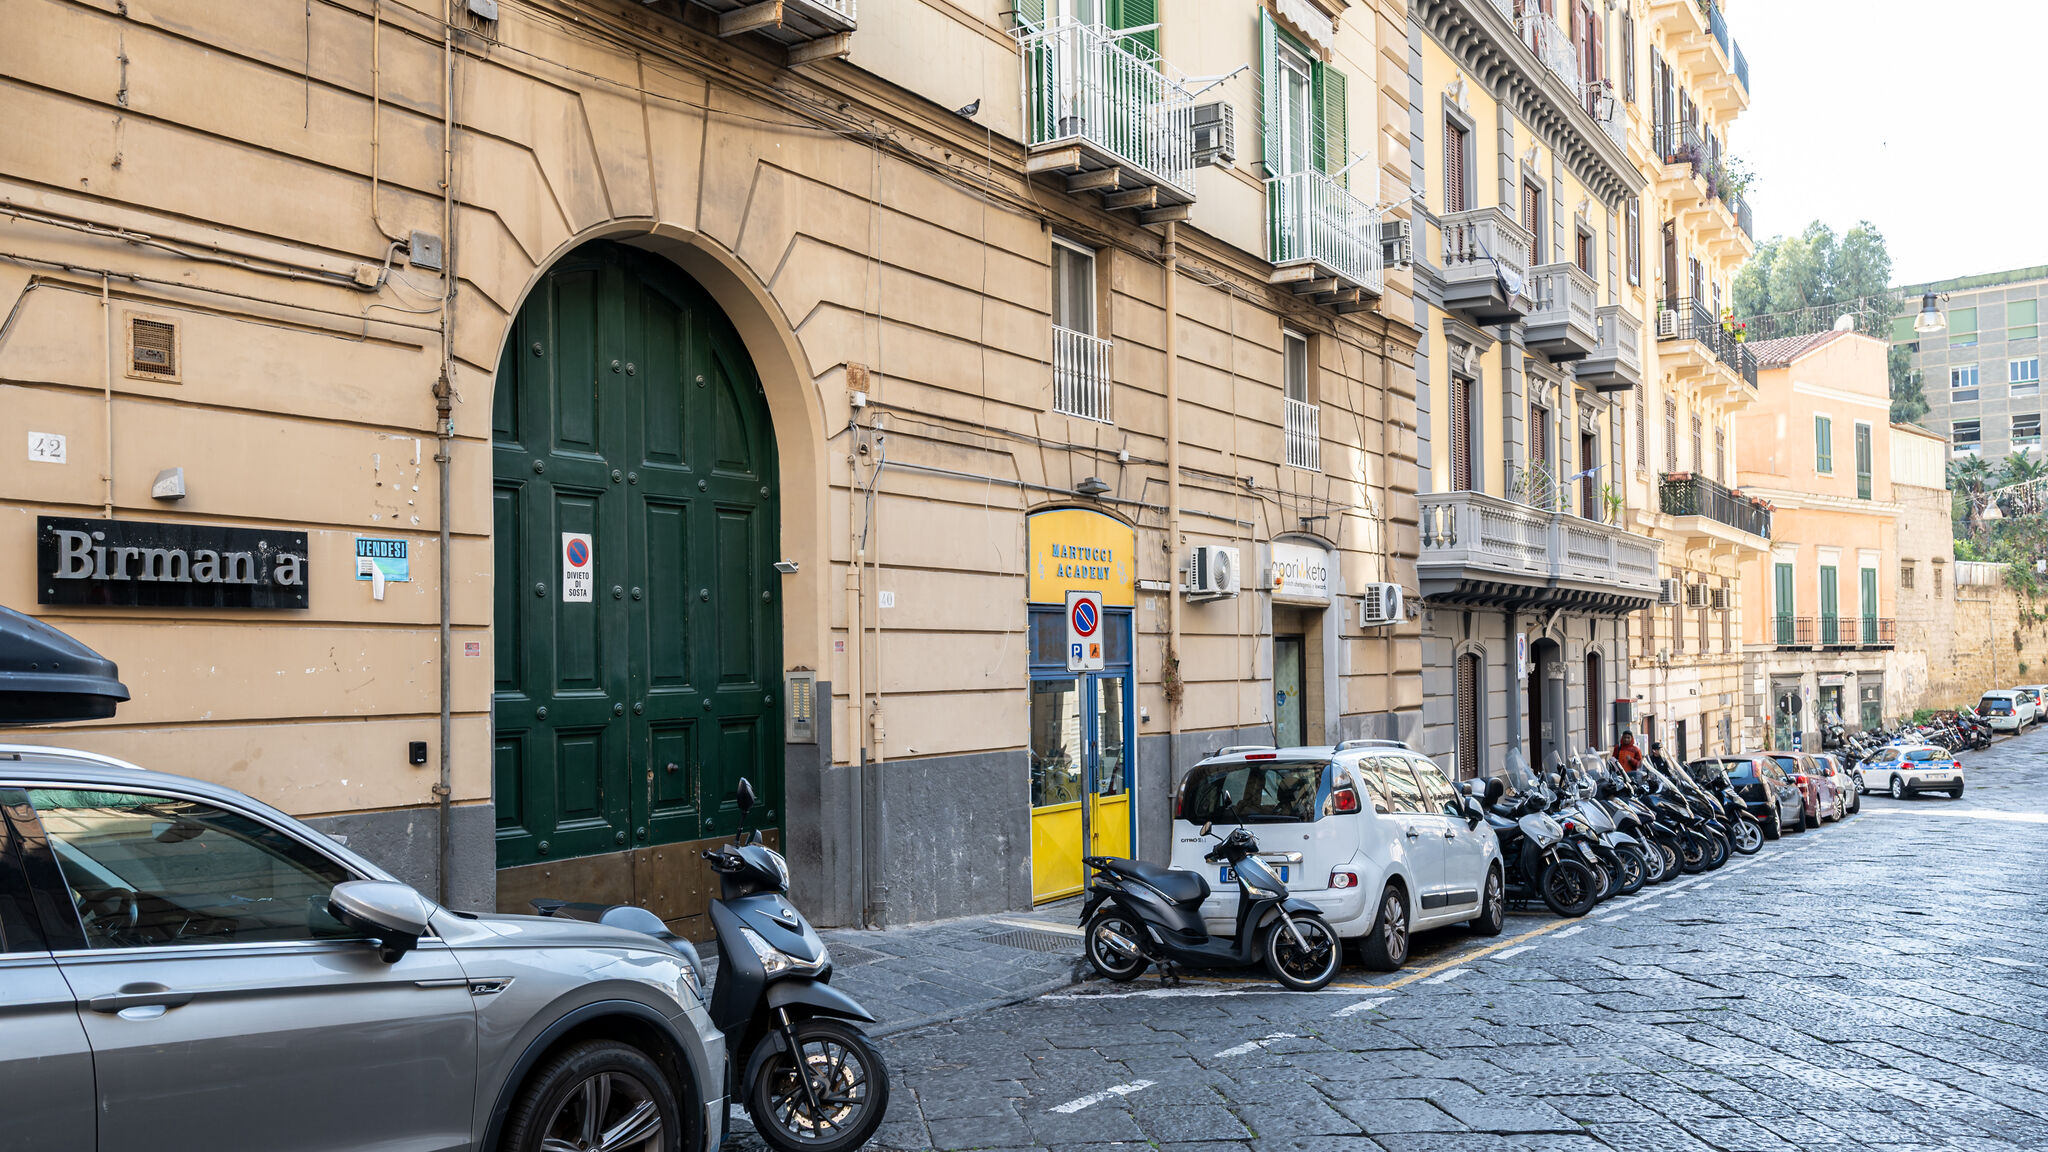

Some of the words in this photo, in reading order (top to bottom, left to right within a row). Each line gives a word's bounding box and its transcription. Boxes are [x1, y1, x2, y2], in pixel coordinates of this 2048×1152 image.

[33, 438, 61, 458] 42
[52, 529, 304, 586] Birmana
[358, 540, 405, 558] VENDESI
[1052, 543, 1113, 562] MARTUCCI
[566, 571, 590, 580] DIVIETO
[1057, 563, 1110, 580] ACADEMY
[568, 588, 587, 597] SOSTA
[574, 580, 582, 588] DI
[881, 592, 893, 606] 40
